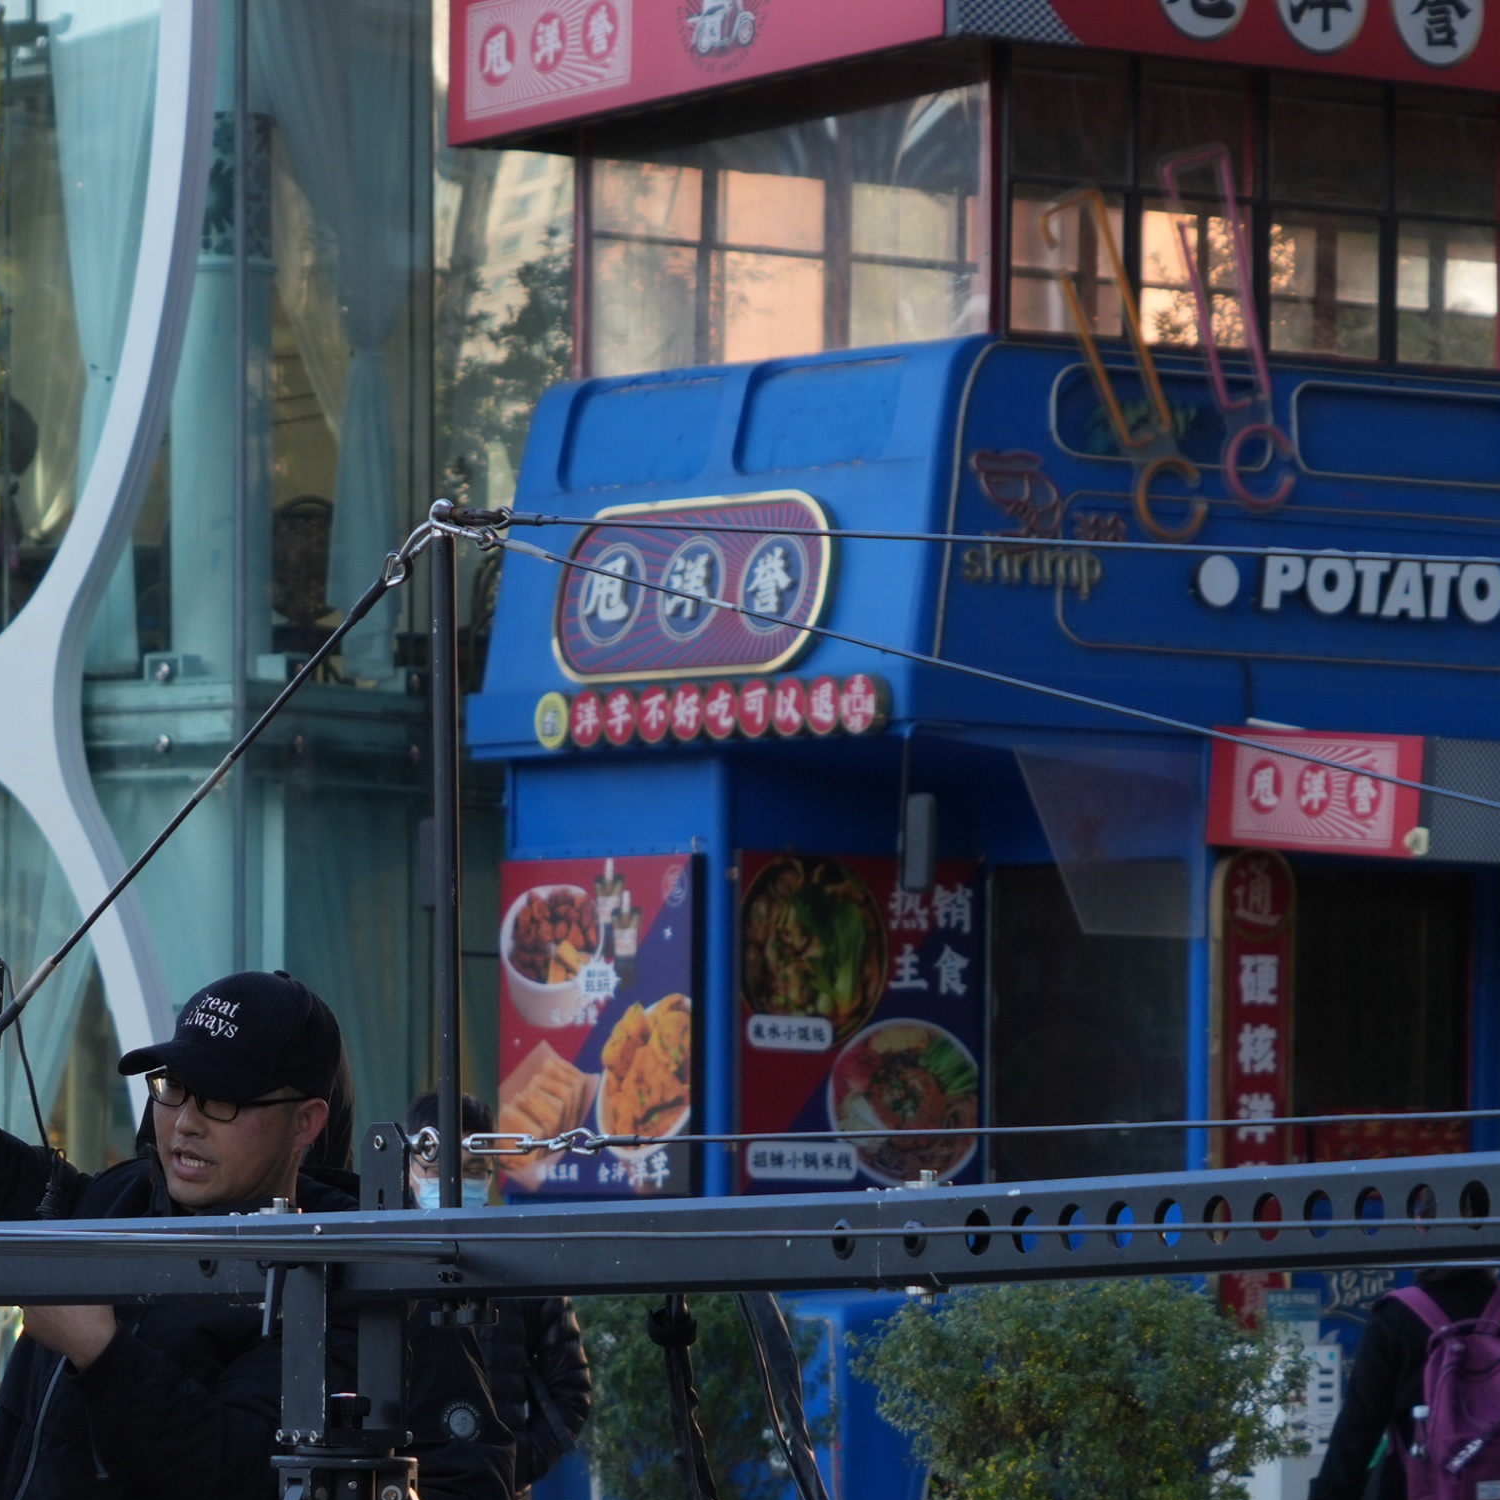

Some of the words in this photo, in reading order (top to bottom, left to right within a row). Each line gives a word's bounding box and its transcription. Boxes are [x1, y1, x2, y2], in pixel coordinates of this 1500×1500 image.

[963, 532, 1102, 599] shrimp
[574, 681, 835, 736] 洋芋不好吃可以退
[889, 883, 974, 934] 热销
[889, 943, 971, 996] 主食
[1237, 953, 1279, 1168] 硬核洋
[752, 1149, 853, 1171] 招牌小锅米线
